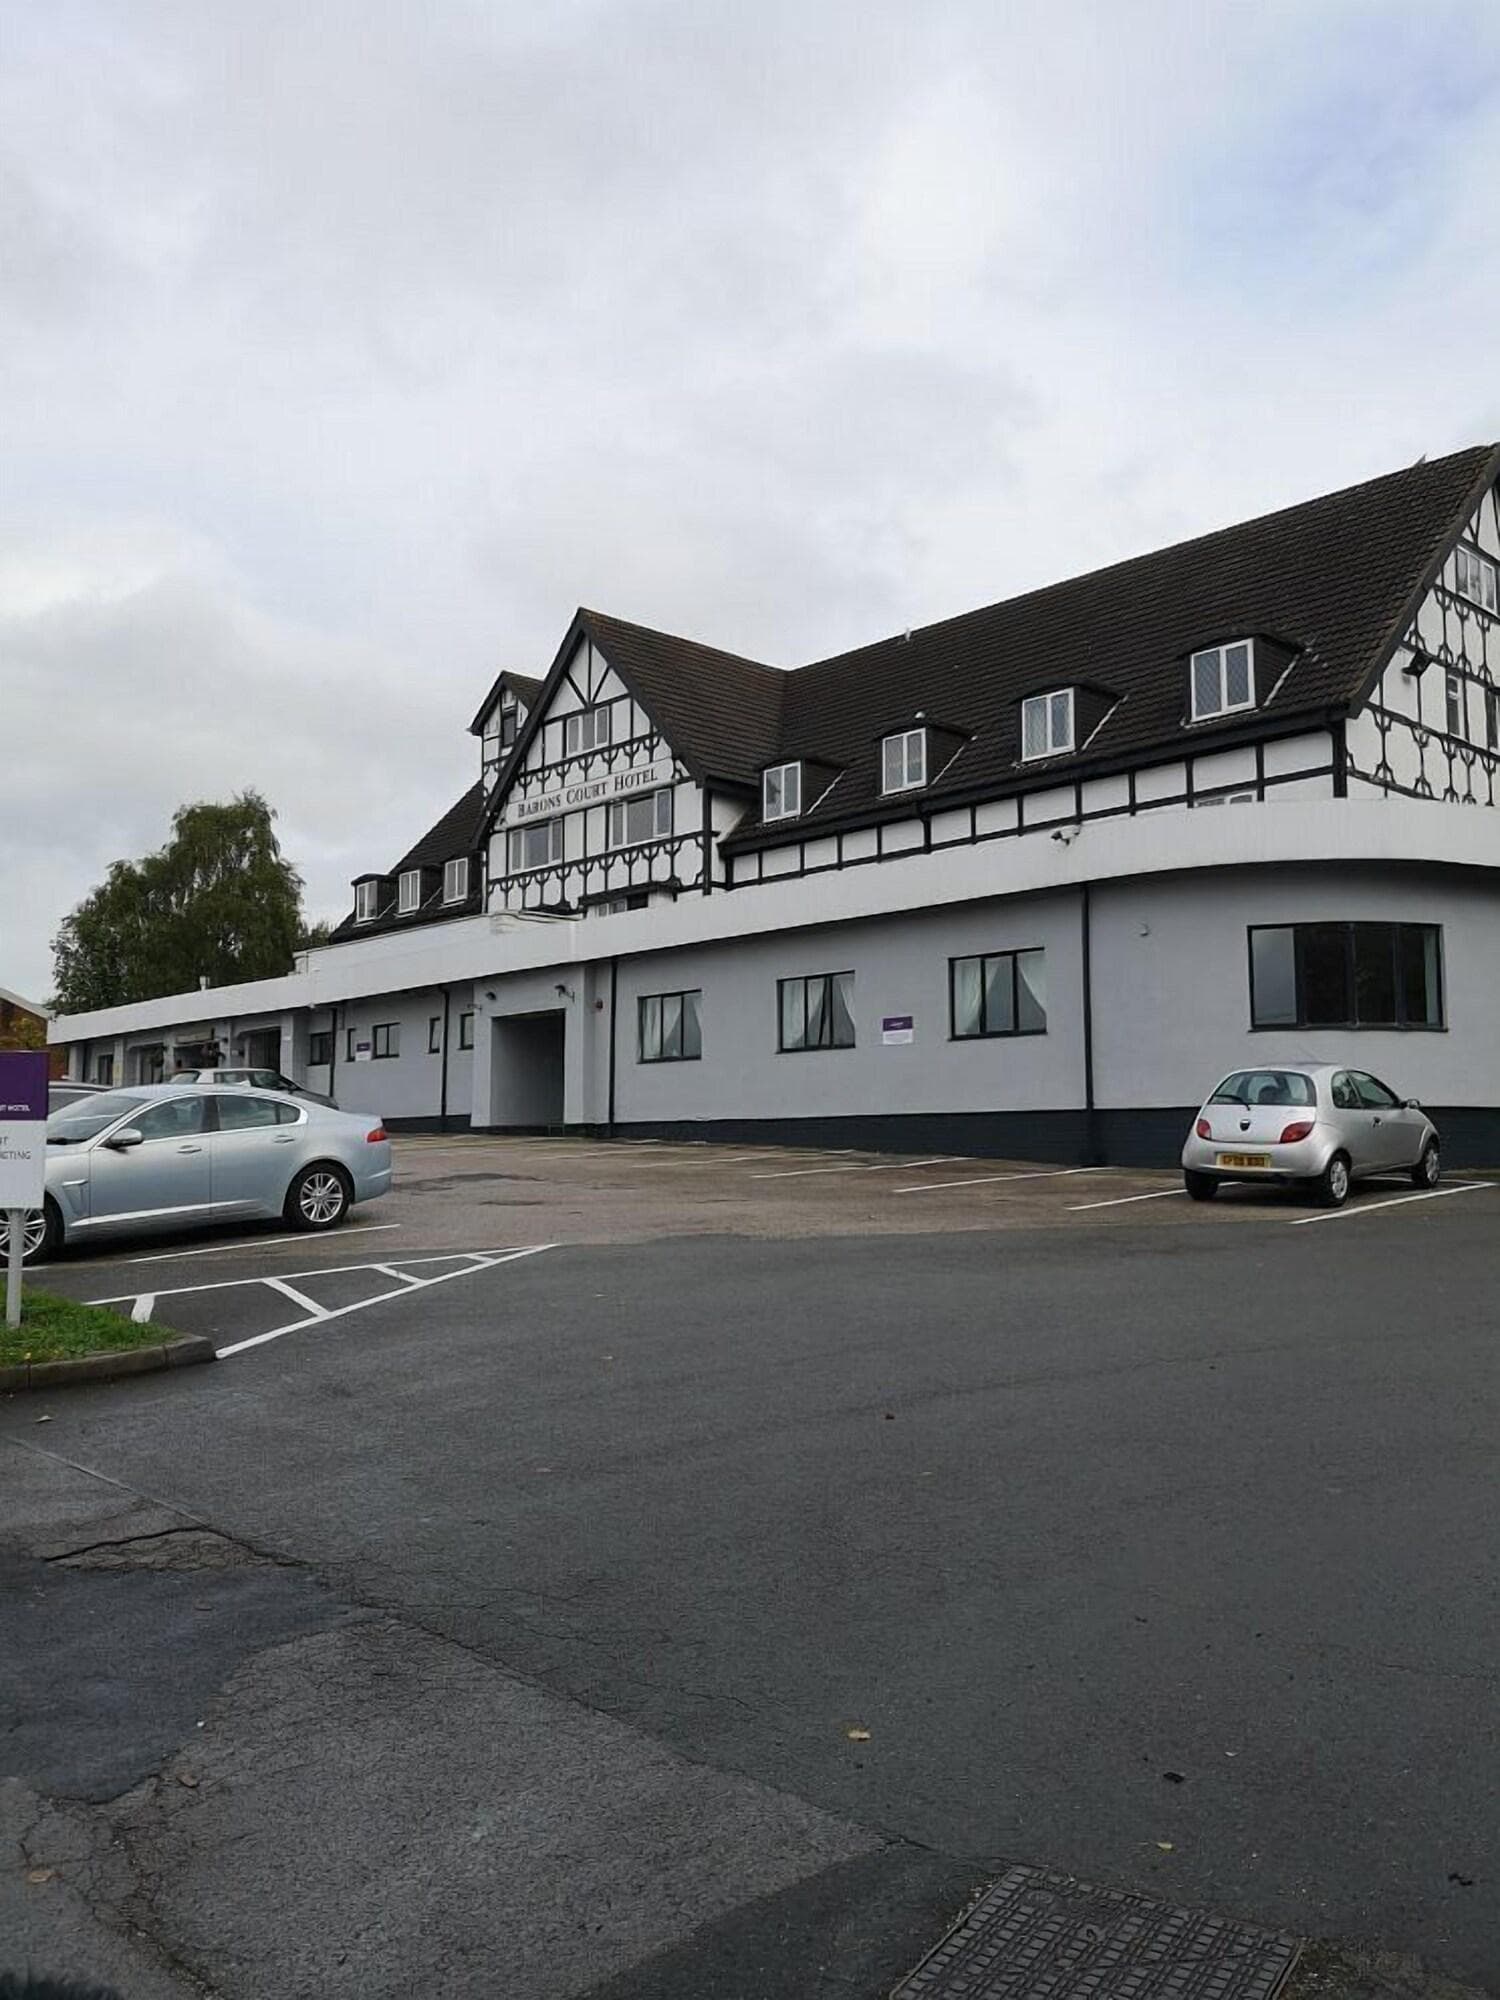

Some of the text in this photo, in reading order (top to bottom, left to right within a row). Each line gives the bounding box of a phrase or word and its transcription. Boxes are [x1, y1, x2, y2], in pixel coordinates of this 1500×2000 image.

[518, 768, 657, 817] BARONS COURT HOTEL
